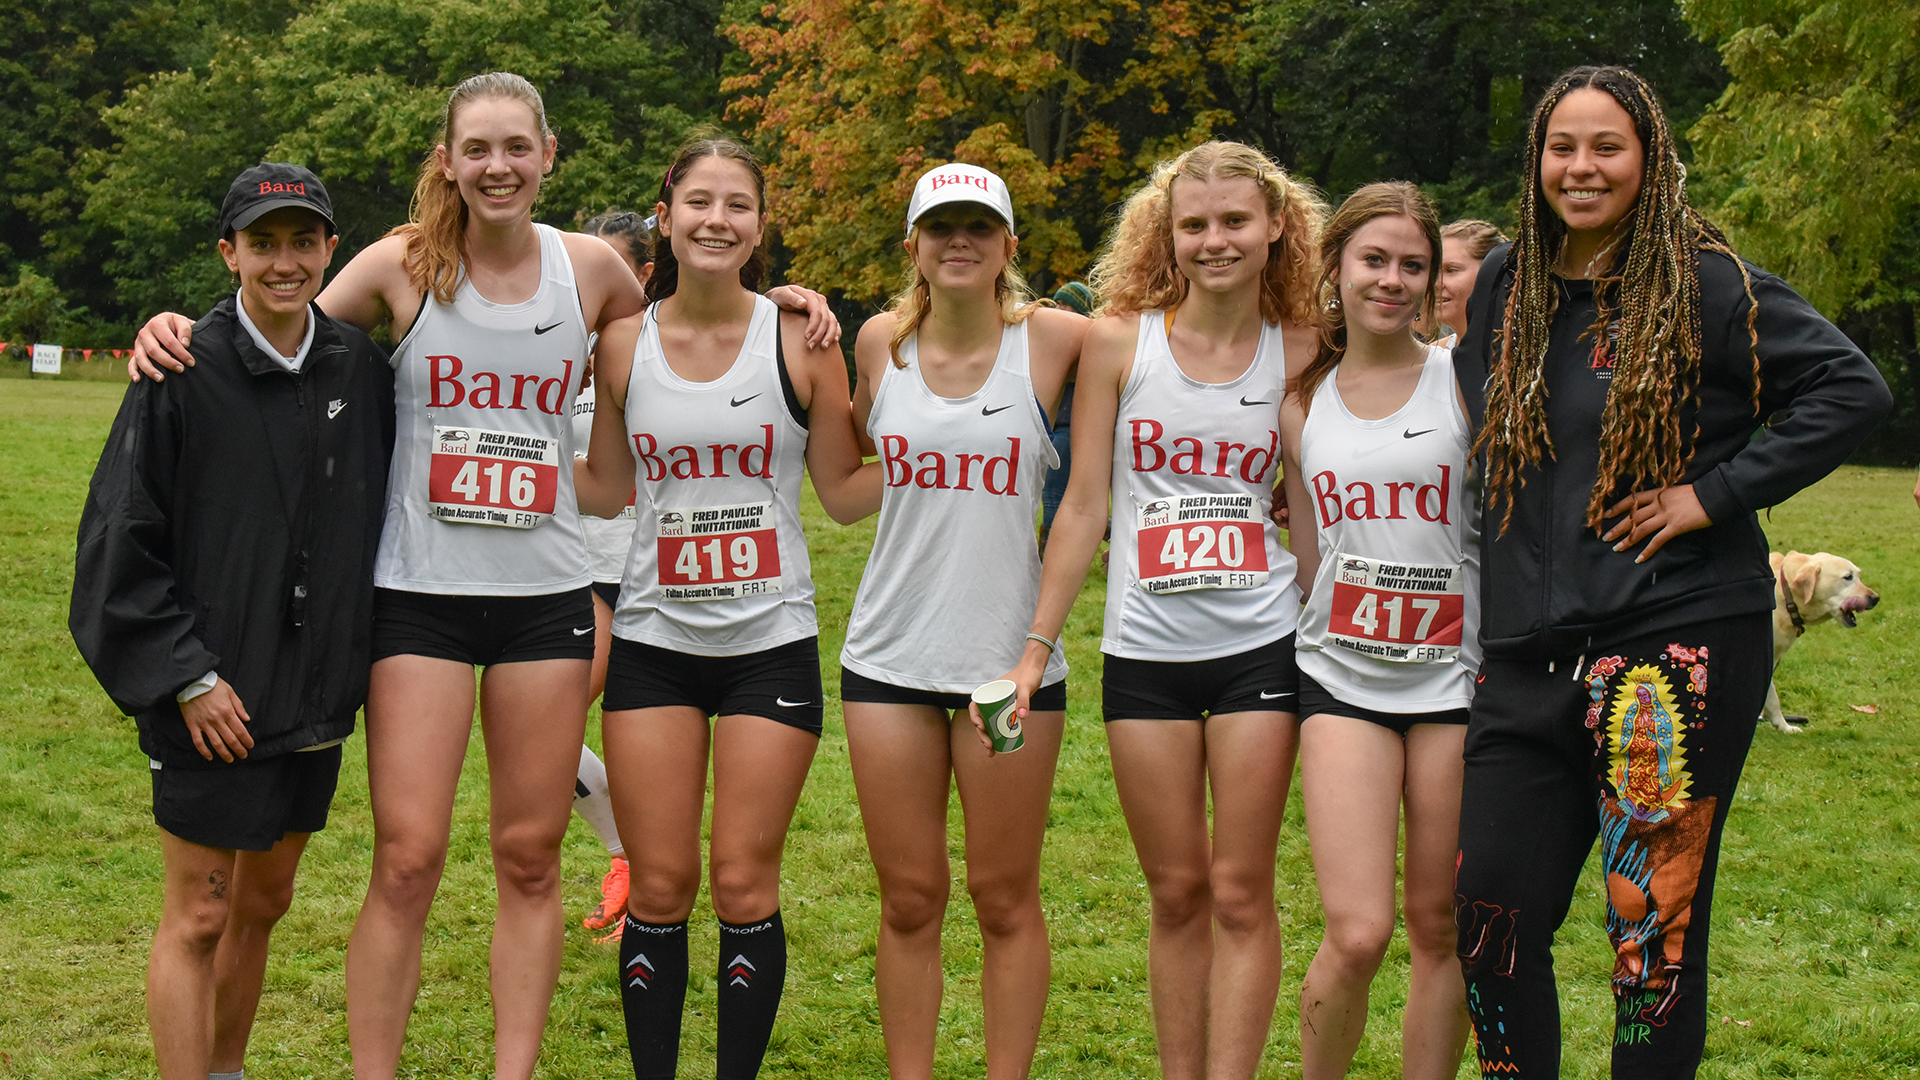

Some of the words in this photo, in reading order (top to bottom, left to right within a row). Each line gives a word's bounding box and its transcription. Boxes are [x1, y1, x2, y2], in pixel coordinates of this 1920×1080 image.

[258, 181, 306, 196] Bard
[931, 174, 989, 193] Bard
[37, 351, 56, 359] RACE
[1590, 347, 1616, 368] Ba
[425, 355, 573, 416] Bard
[572, 402, 595, 417] IDDL
[440, 442, 467, 454] Bard
[479, 432, 506, 445] FRED
[506, 436, 548, 450] PAVLICH
[475, 444, 544, 461] INVITATIONAL
[632, 424, 774, 482] Bard
[1128, 418, 1279, 484] Bard
[880, 434, 1021, 497] Bard
[451, 460, 537, 508] 416
[1179, 496, 1207, 508] FRED
[1208, 496, 1252, 508] PAVLICH
[1311, 464, 1452, 530] Bard
[436, 506, 456, 518] Fulton
[456, 507, 486, 520] Accurate
[487, 510, 508, 524] Timing
[620, 508, 631, 517] AT
[692, 510, 719, 522] FRED
[720, 505, 764, 520] PAVLICH
[1144, 513, 1170, 527] Bard
[1178, 508, 1250, 521] INVITATIONAL
[661, 525, 684, 536] Bard
[691, 518, 761, 534] INVITATIONAL
[1160, 525, 1245, 570] 420
[674, 535, 759, 581] 419
[1342, 571, 1368, 586] Bard
[1378, 564, 1406, 577] FRED
[1407, 567, 1453, 579] PAVLICH
[1148, 580, 1169, 592] Fulton
[1169, 576, 1198, 589] Accurate
[1199, 573, 1222, 586] Timing
[1375, 576, 1448, 591] INVITATIONAL
[665, 588, 684, 599] Fulton
[683, 587, 712, 599] Accurate
[712, 585, 735, 597] Timing
[1351, 592, 1441, 641] 417
[1335, 637, 1355, 650] Fulton
[1355, 641, 1385, 656] Accurate
[1385, 645, 1409, 660] Timing
